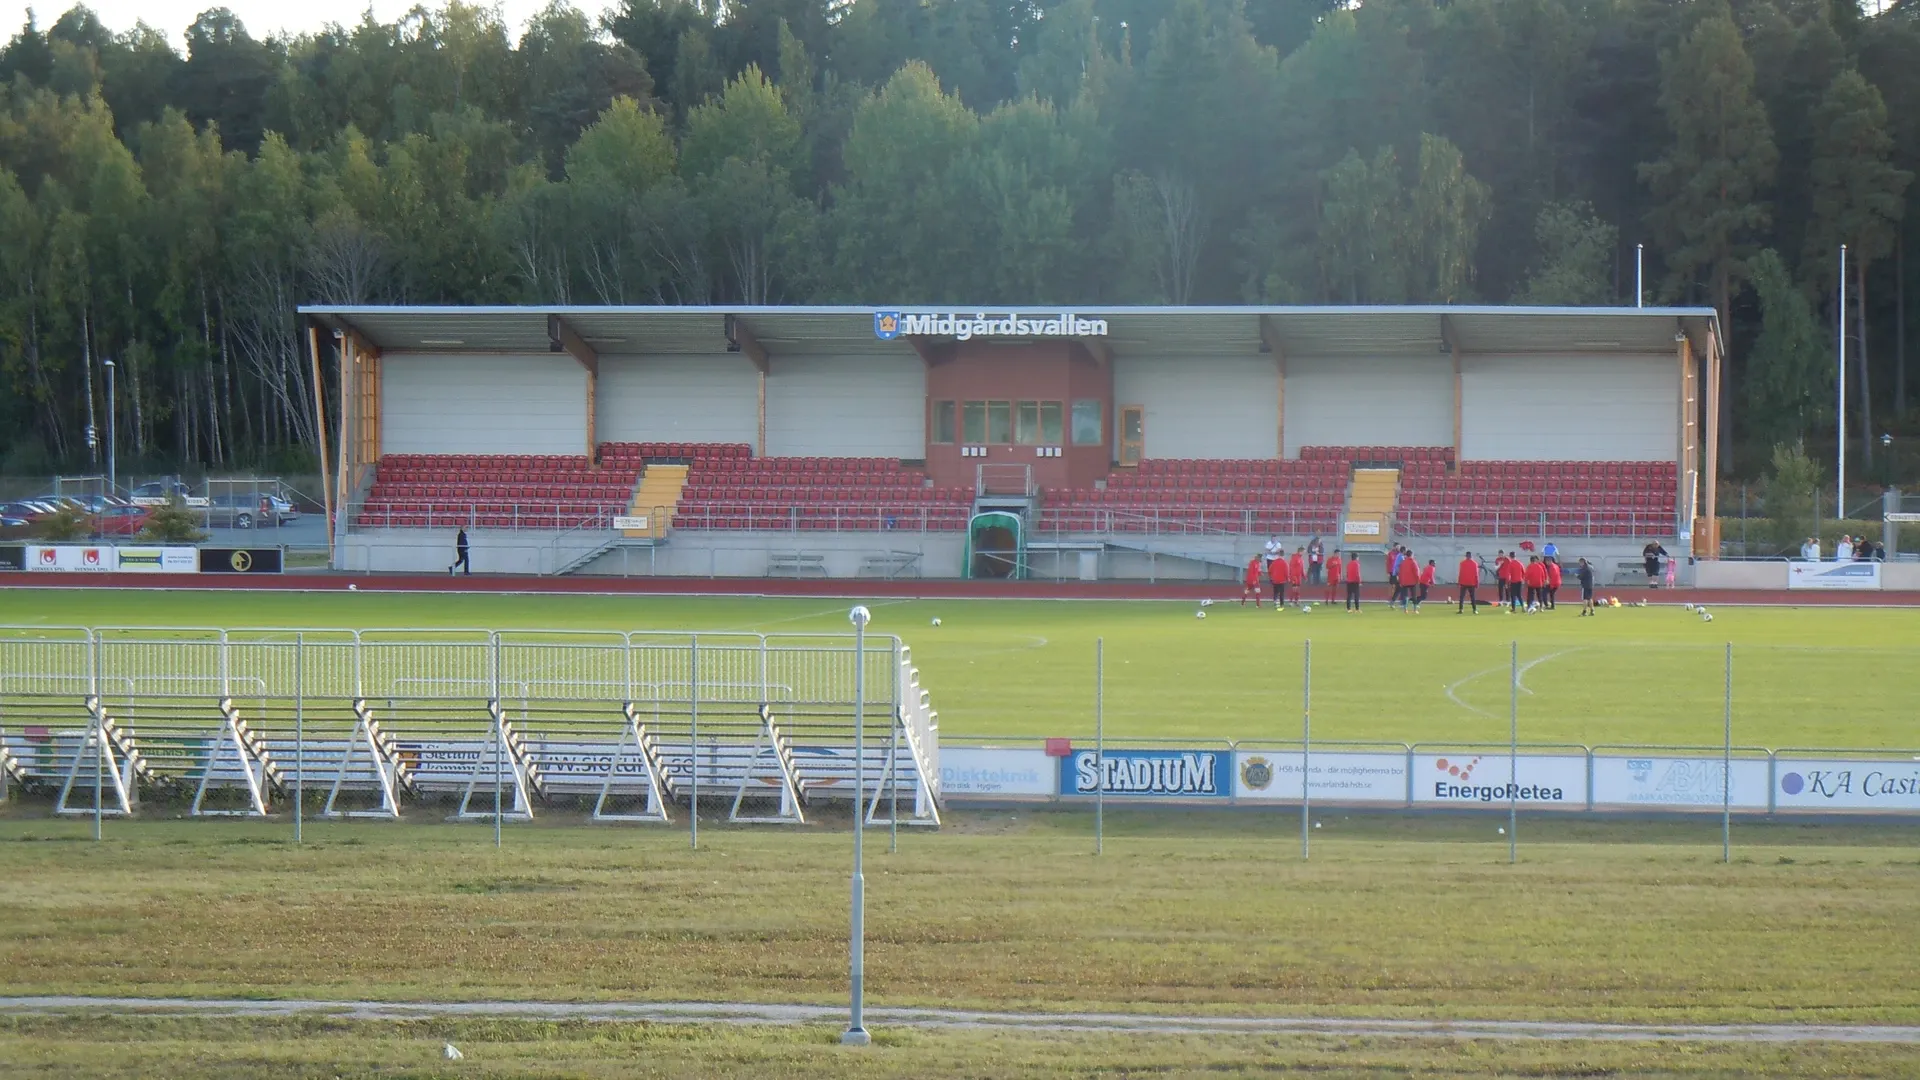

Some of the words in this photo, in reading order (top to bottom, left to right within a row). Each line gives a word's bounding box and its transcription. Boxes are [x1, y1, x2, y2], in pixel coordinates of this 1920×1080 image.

[905, 312, 1108, 340] Midgårdsvallen
[1077, 752, 1216, 795] STADIUM
[1808, 771, 1852, 798] KA
[1863, 771, 1920, 797] Casi
[1435, 782, 1562, 801] EnergoRetea
